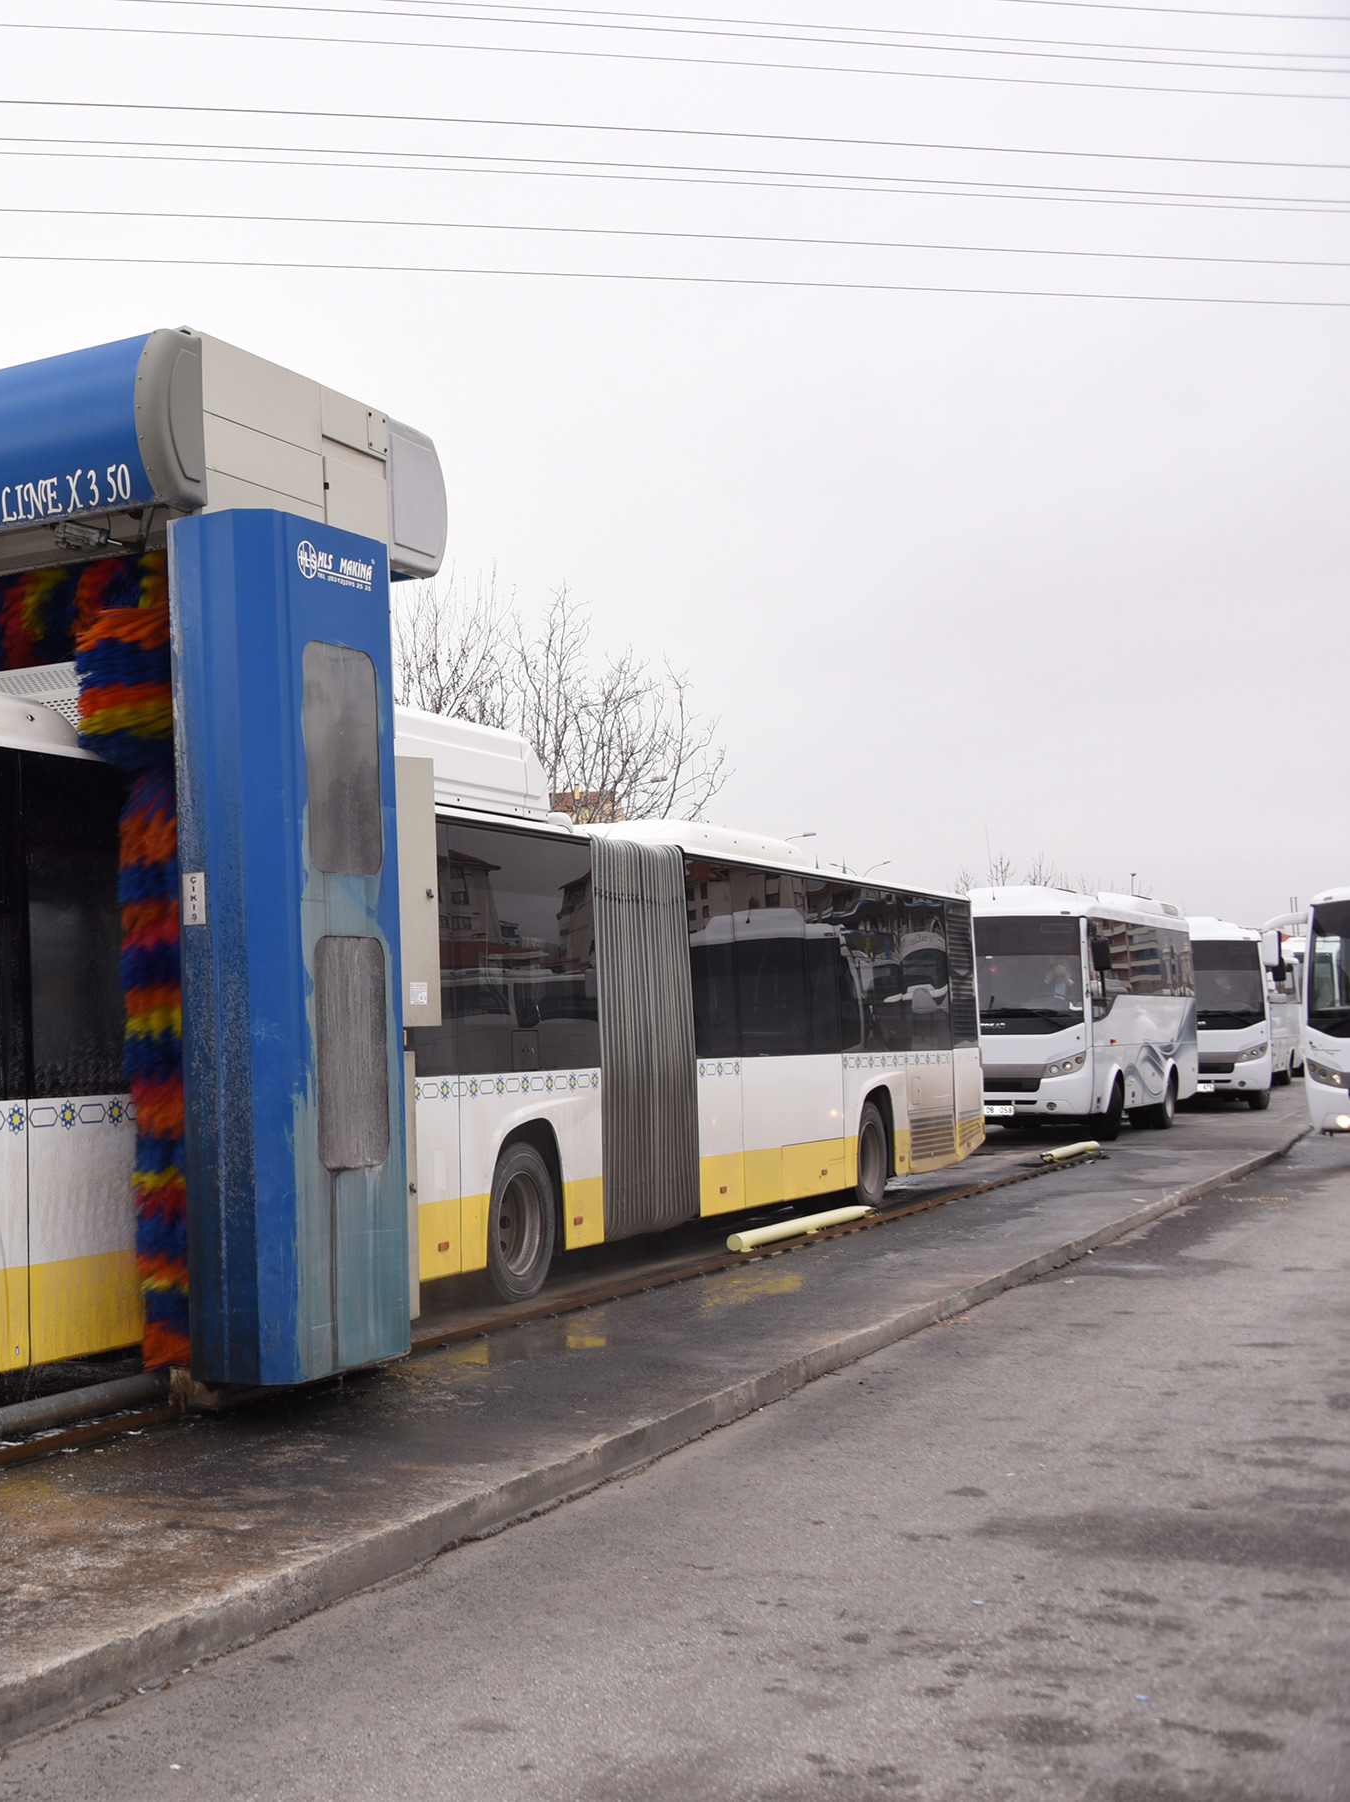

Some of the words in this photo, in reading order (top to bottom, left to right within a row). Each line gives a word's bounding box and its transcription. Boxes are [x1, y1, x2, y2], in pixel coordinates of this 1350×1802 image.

[1, 477, 63, 522] LINE
[66, 469, 83, 513] X
[87, 469, 100, 507] 3
[106, 463, 131, 503] 50
[317, 572, 326, 580] TEL
[318, 551, 333, 570] HLS
[190, 876, 198, 921] ÇIKIŞ
